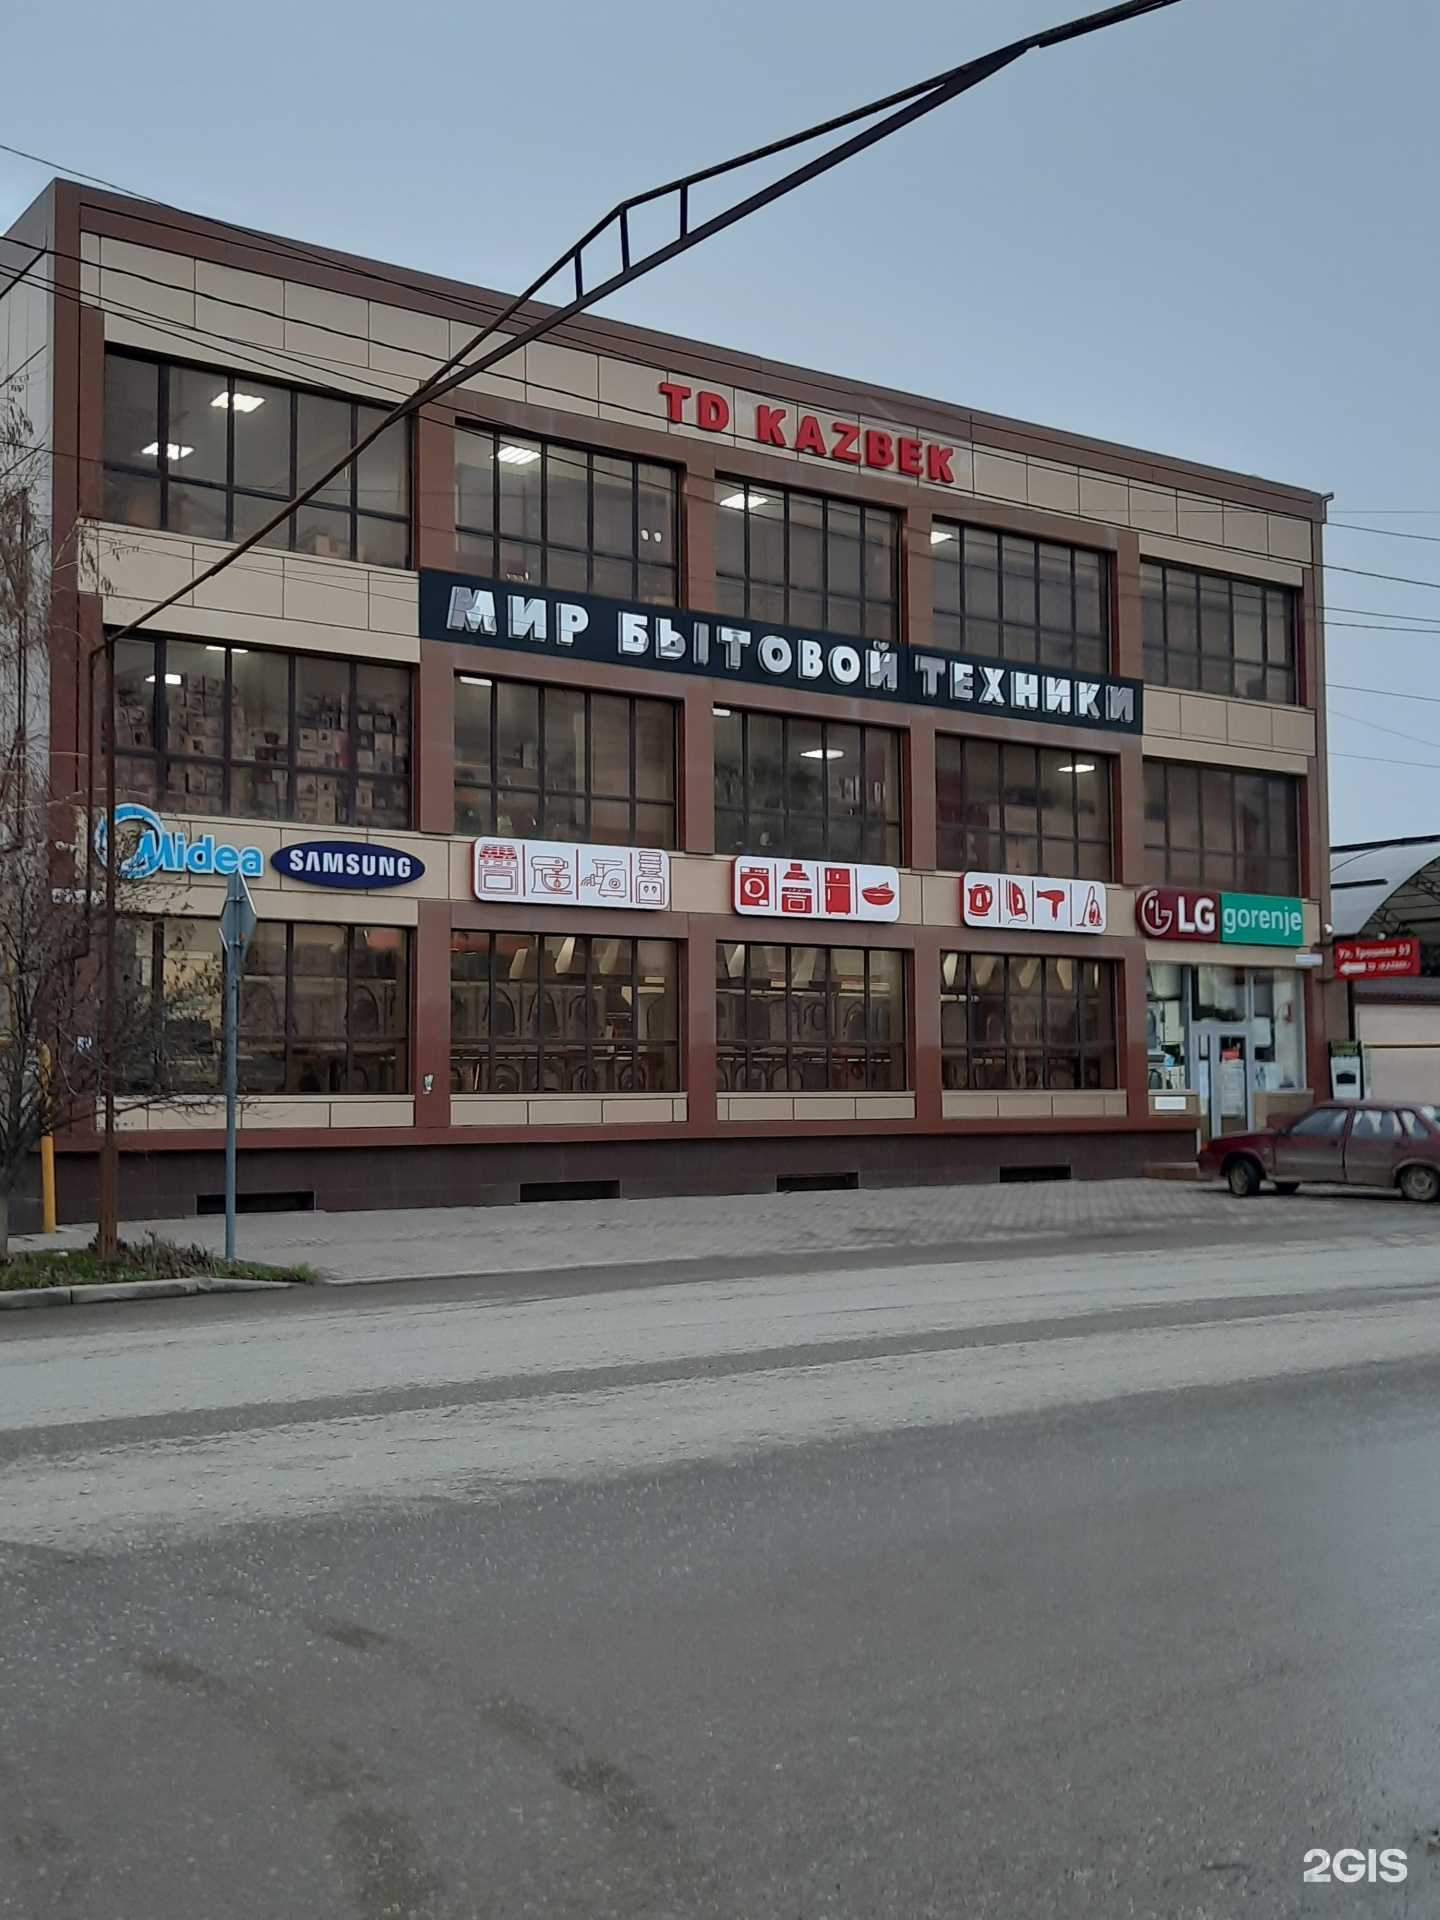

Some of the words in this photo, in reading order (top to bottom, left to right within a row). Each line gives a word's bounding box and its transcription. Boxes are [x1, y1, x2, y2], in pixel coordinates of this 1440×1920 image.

[659, 382, 730, 433] TD
[757, 404, 955, 484] KAZBEK
[446, 586, 590, 647] МИР
[617, 610, 899, 692] БЫТОВОЙ
[914, 653, 1135, 723] ТЕХНИКИ
[118, 828, 264, 879] Midea
[288, 850, 412, 879] SAMSUNG
[1178, 896, 1216, 934] LG
[1223, 906, 1303, 937] gorenje
